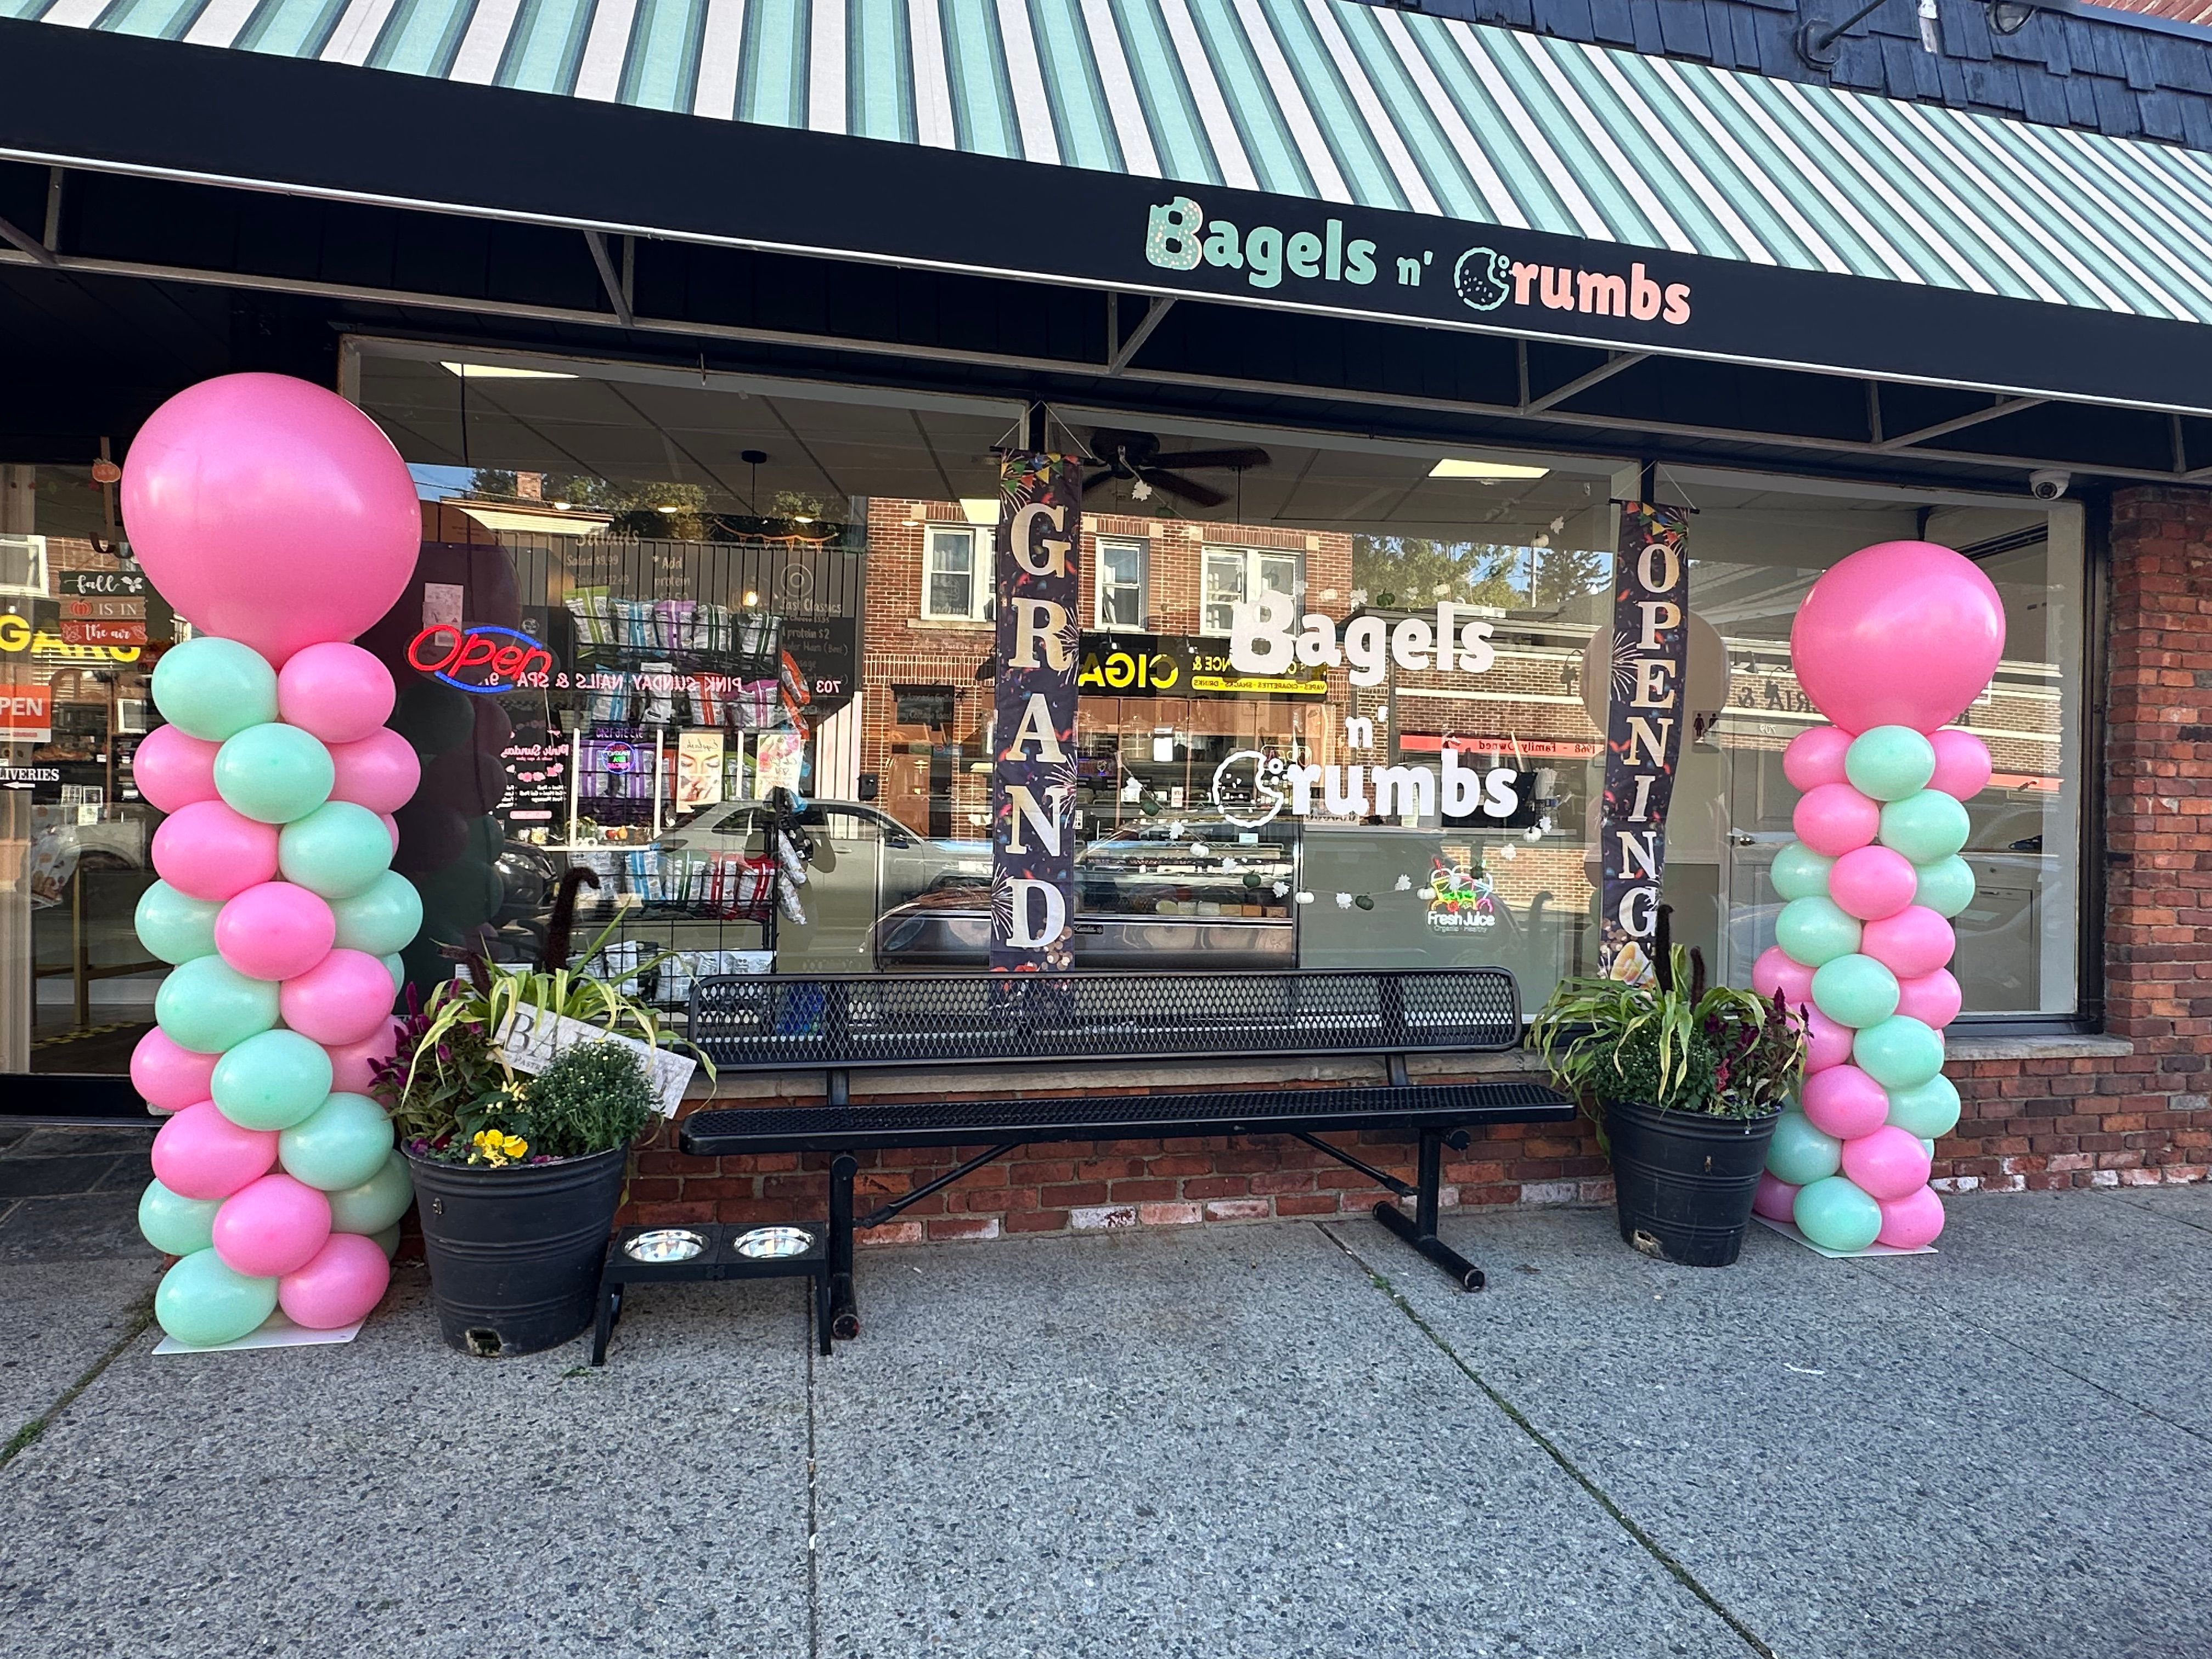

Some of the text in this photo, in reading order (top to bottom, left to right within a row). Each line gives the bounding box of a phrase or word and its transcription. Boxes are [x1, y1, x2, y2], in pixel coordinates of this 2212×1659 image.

[1146, 196, 1691, 324] Bagels n' Crumbs
[662, 557, 683, 569] Add
[64, 575, 120, 594] fall
[99, 603, 136, 615] IS IN
[82, 624, 108, 641] the
[408, 625, 552, 679] Open
[1231, 590, 1494, 686] Bagels
[1005, 503, 1072, 947] GRAND
[1346, 706, 1389, 748] n'
[1617, 543, 1681, 937] OPENING
[1427, 911, 1496, 926] Fresh Juice
